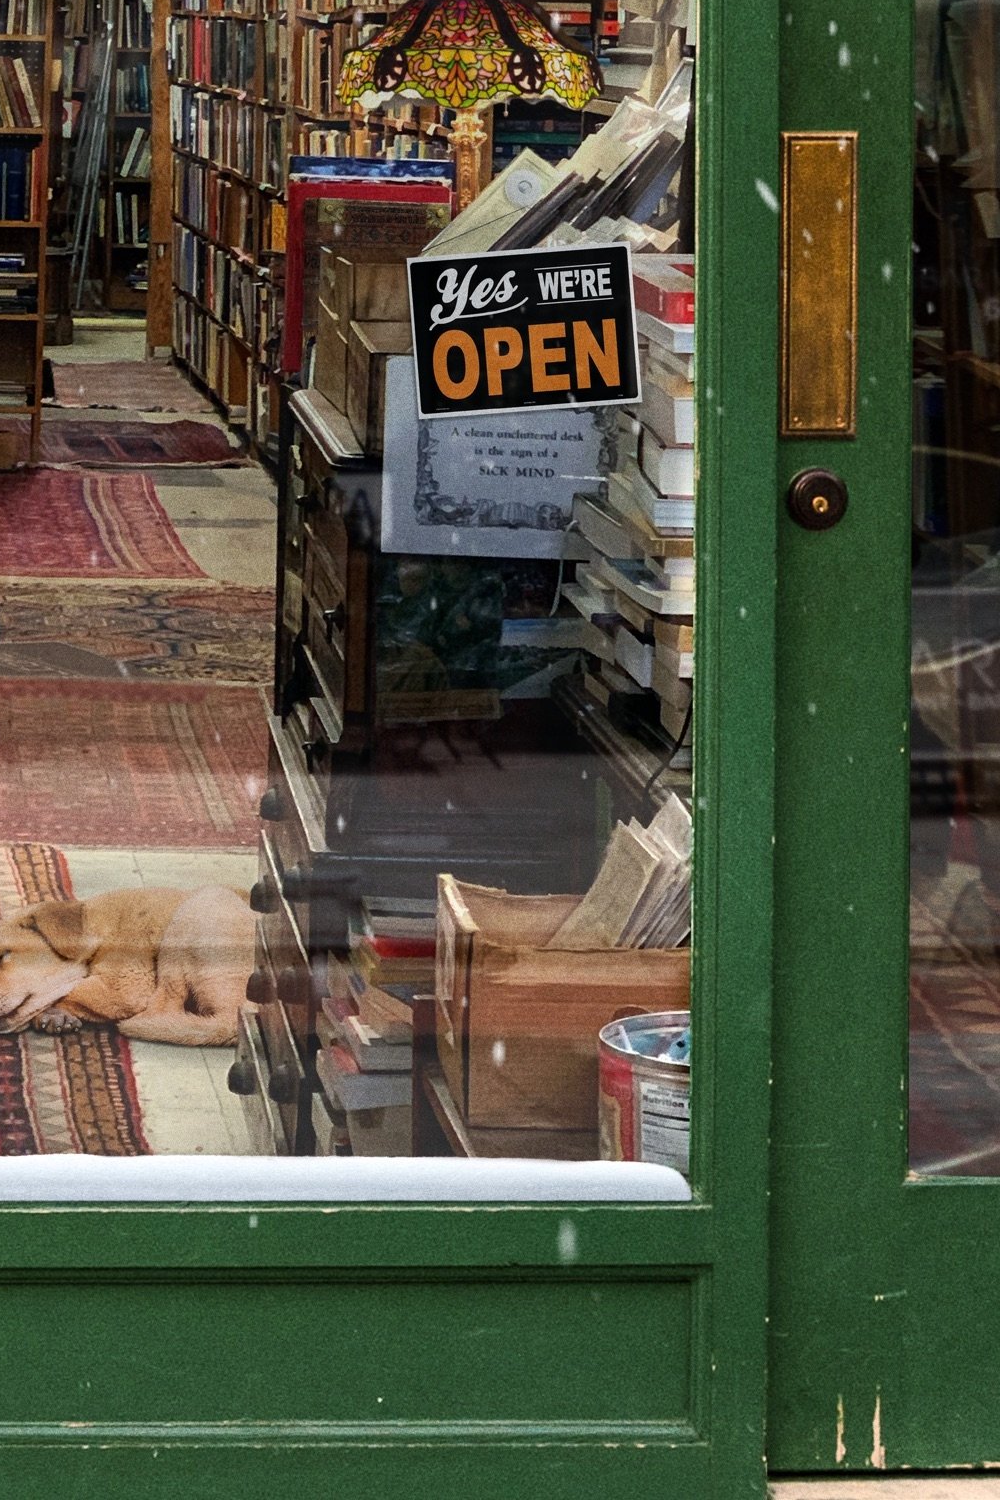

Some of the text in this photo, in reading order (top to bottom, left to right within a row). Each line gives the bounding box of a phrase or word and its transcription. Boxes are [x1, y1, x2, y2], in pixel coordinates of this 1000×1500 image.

[430, 265, 613, 331] Yes WE'RE
[432, 318, 620, 400] OPEN
[451, 427, 584, 442] A clean uncluttered desk
[474, 447, 483, 456] is
[488, 446, 504, 456] the
[510, 448, 533, 458] sign
[537, 448, 549, 458] of
[478, 466, 555, 478] SICK MIND
[643, 1094, 684, 1108] Nutrition
